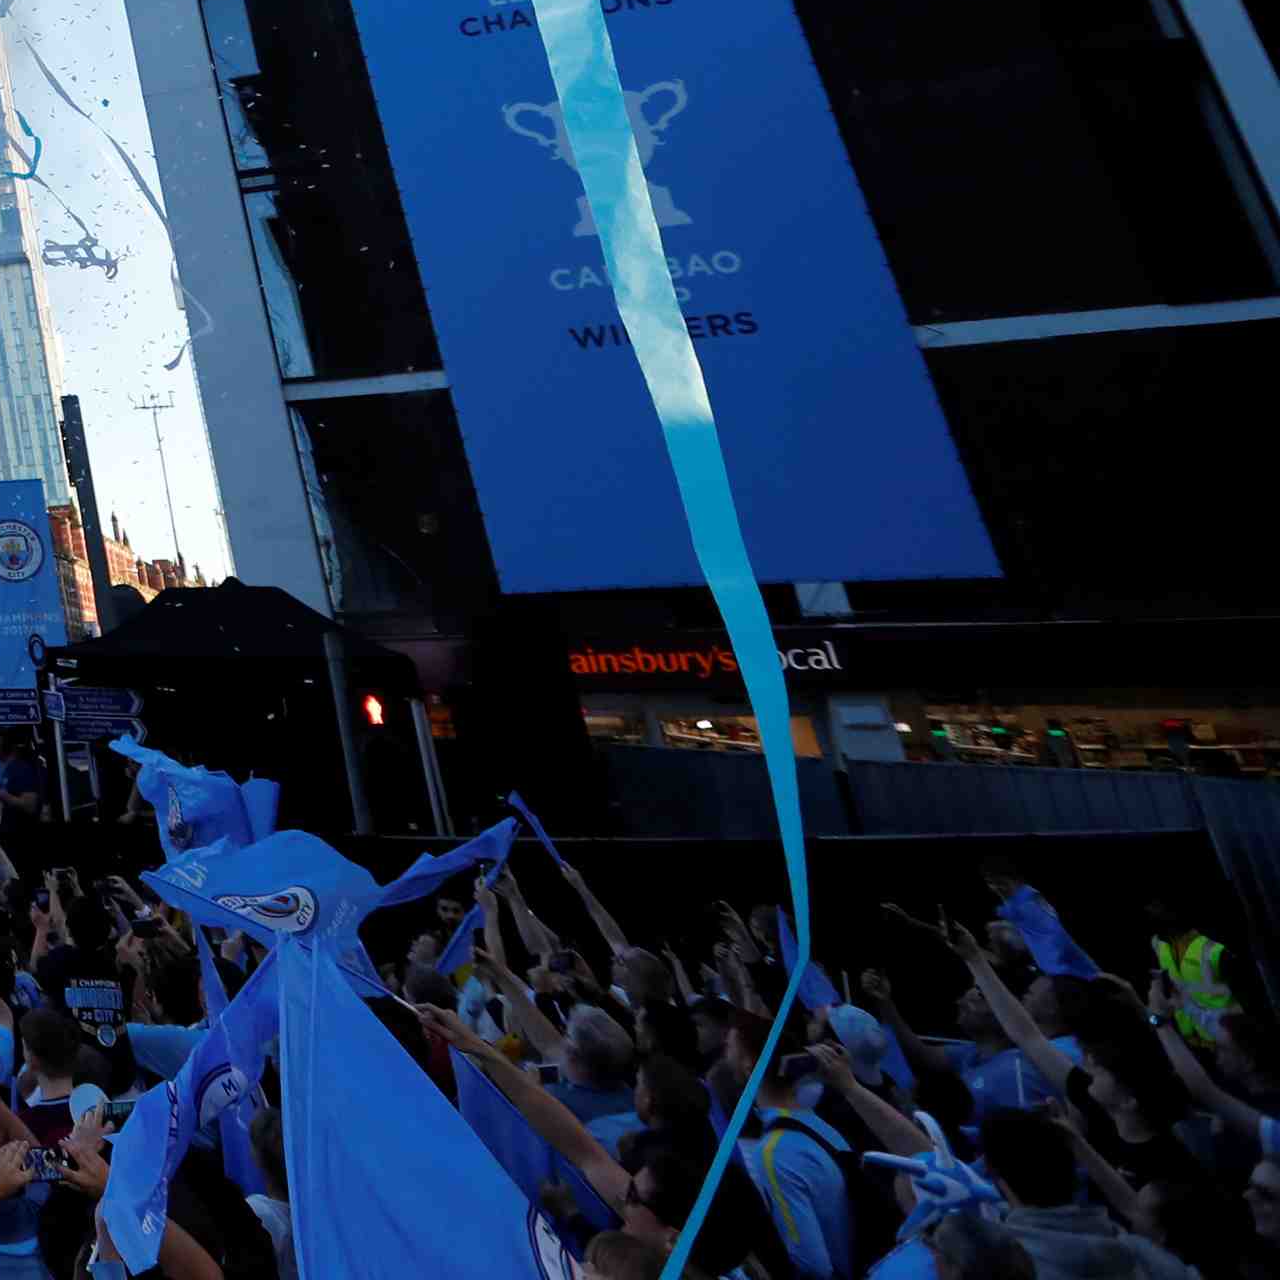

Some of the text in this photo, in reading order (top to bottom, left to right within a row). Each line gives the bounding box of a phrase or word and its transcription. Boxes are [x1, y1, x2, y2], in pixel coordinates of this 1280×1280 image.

[550, 250, 742, 291] CABAO
[568, 312, 759, 349] WIERS
[568, 644, 737, 679] ainsbury's
